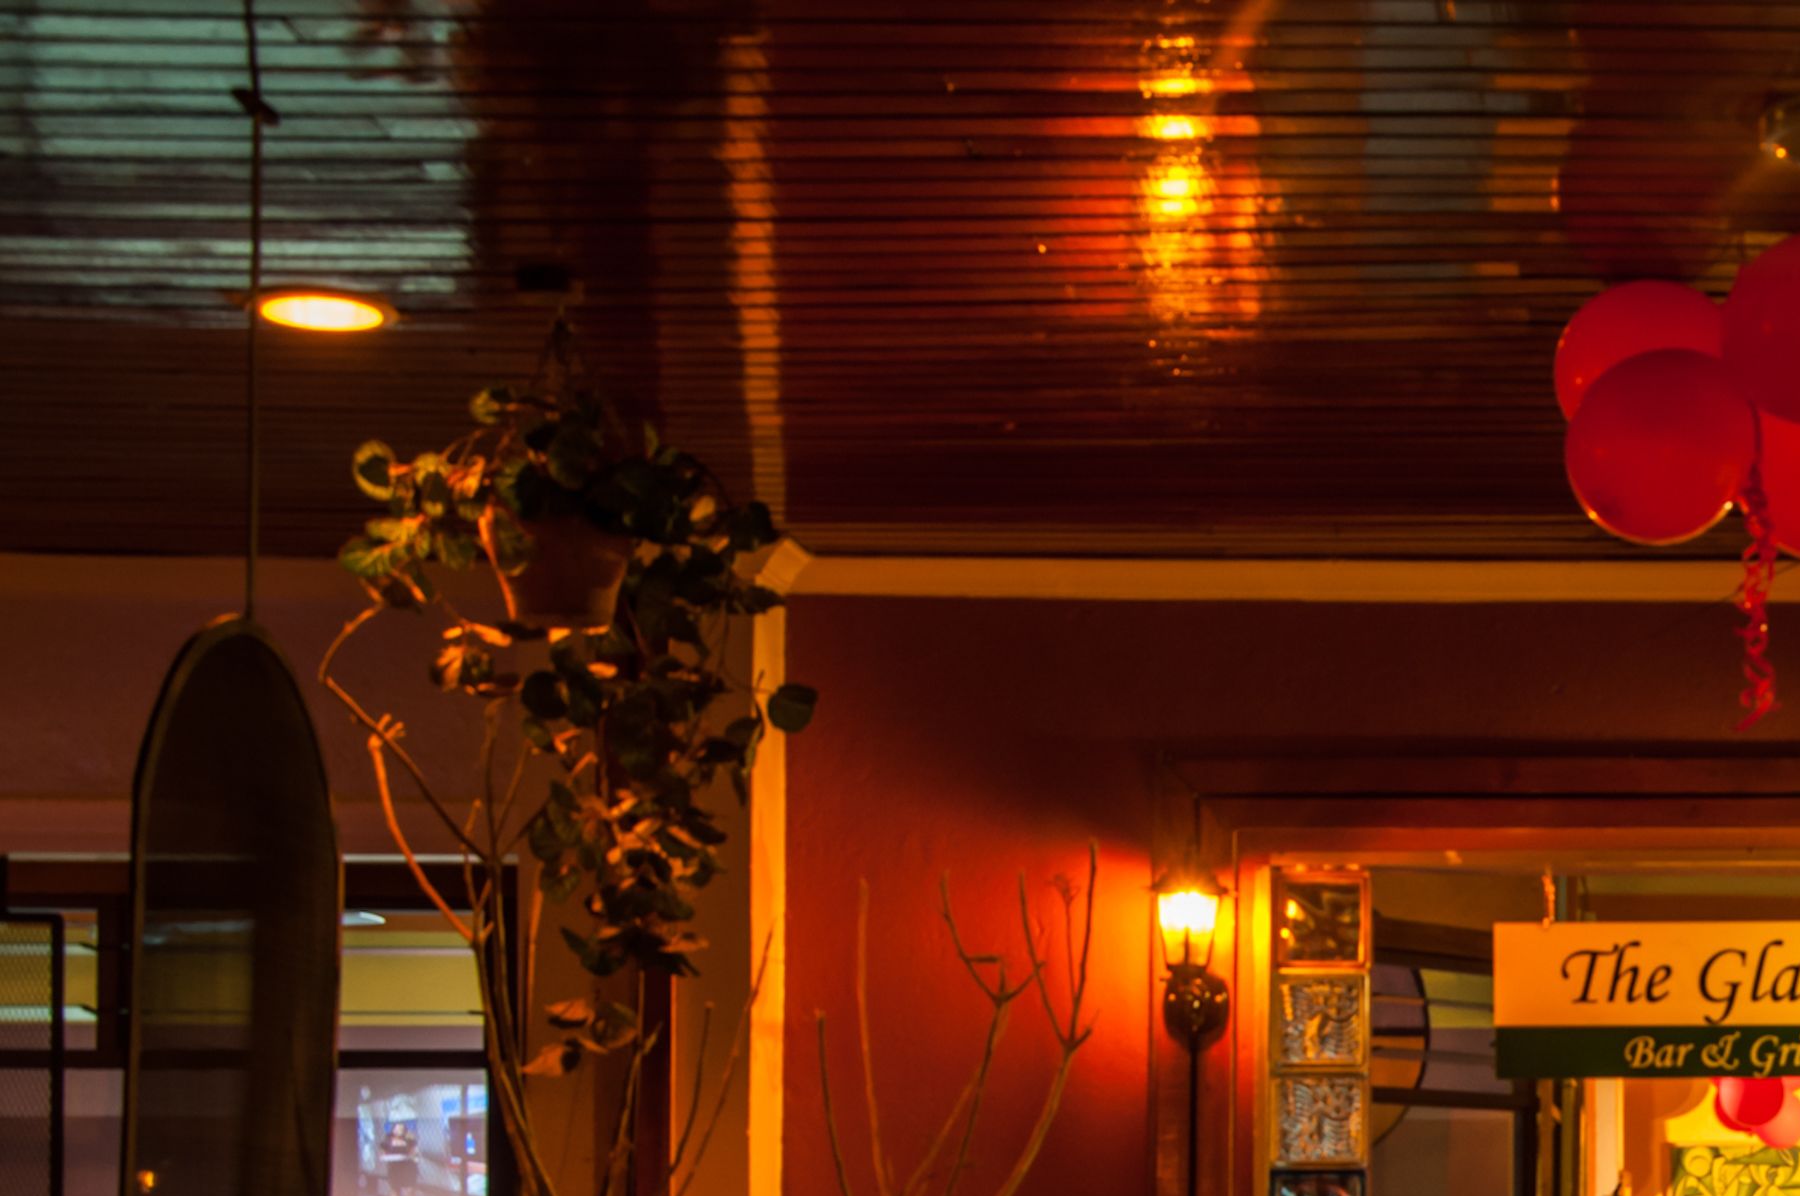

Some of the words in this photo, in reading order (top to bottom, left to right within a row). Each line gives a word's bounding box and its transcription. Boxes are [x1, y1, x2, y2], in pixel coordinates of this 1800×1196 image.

[1560, 941, 1672, 1004] The
[1624, 1036, 1692, 1069] Bar
[1701, 1031, 1740, 1068] &
